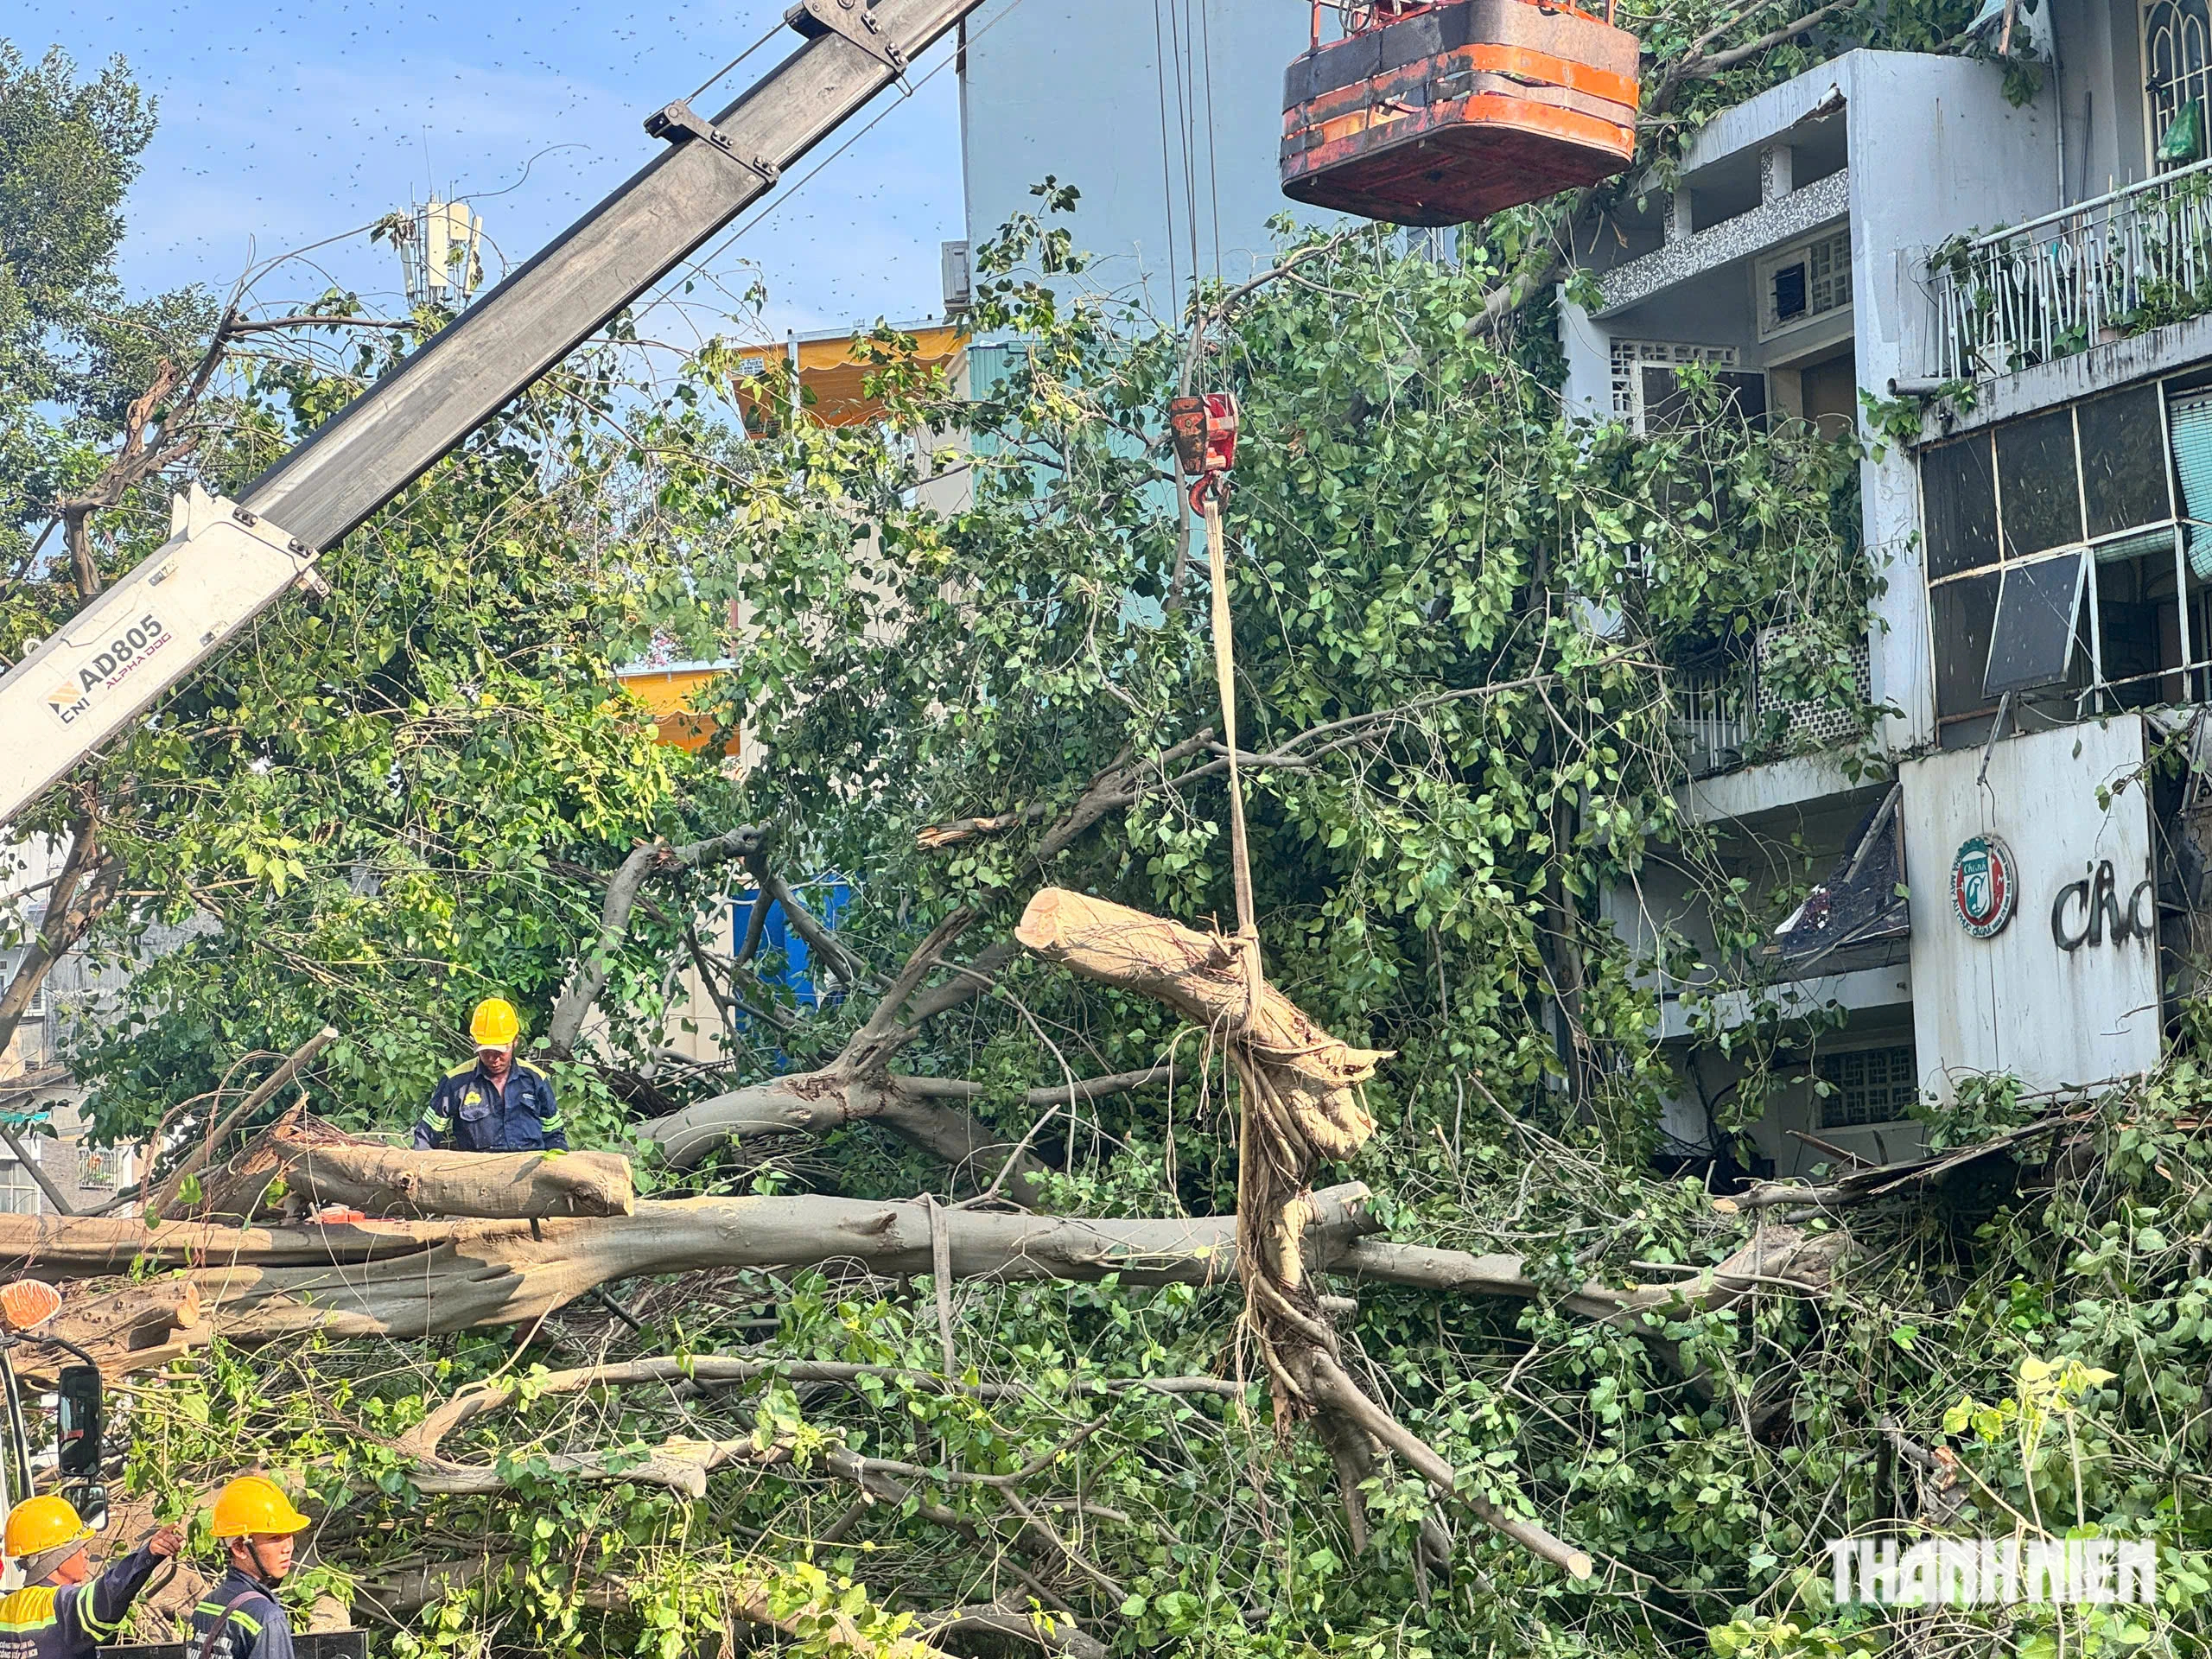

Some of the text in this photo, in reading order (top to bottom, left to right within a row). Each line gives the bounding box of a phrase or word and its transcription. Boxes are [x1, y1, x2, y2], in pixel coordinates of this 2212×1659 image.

[79, 613, 162, 693] AD805
[105, 655, 145, 690] ALPHA
[60, 696, 91, 724] CNI
